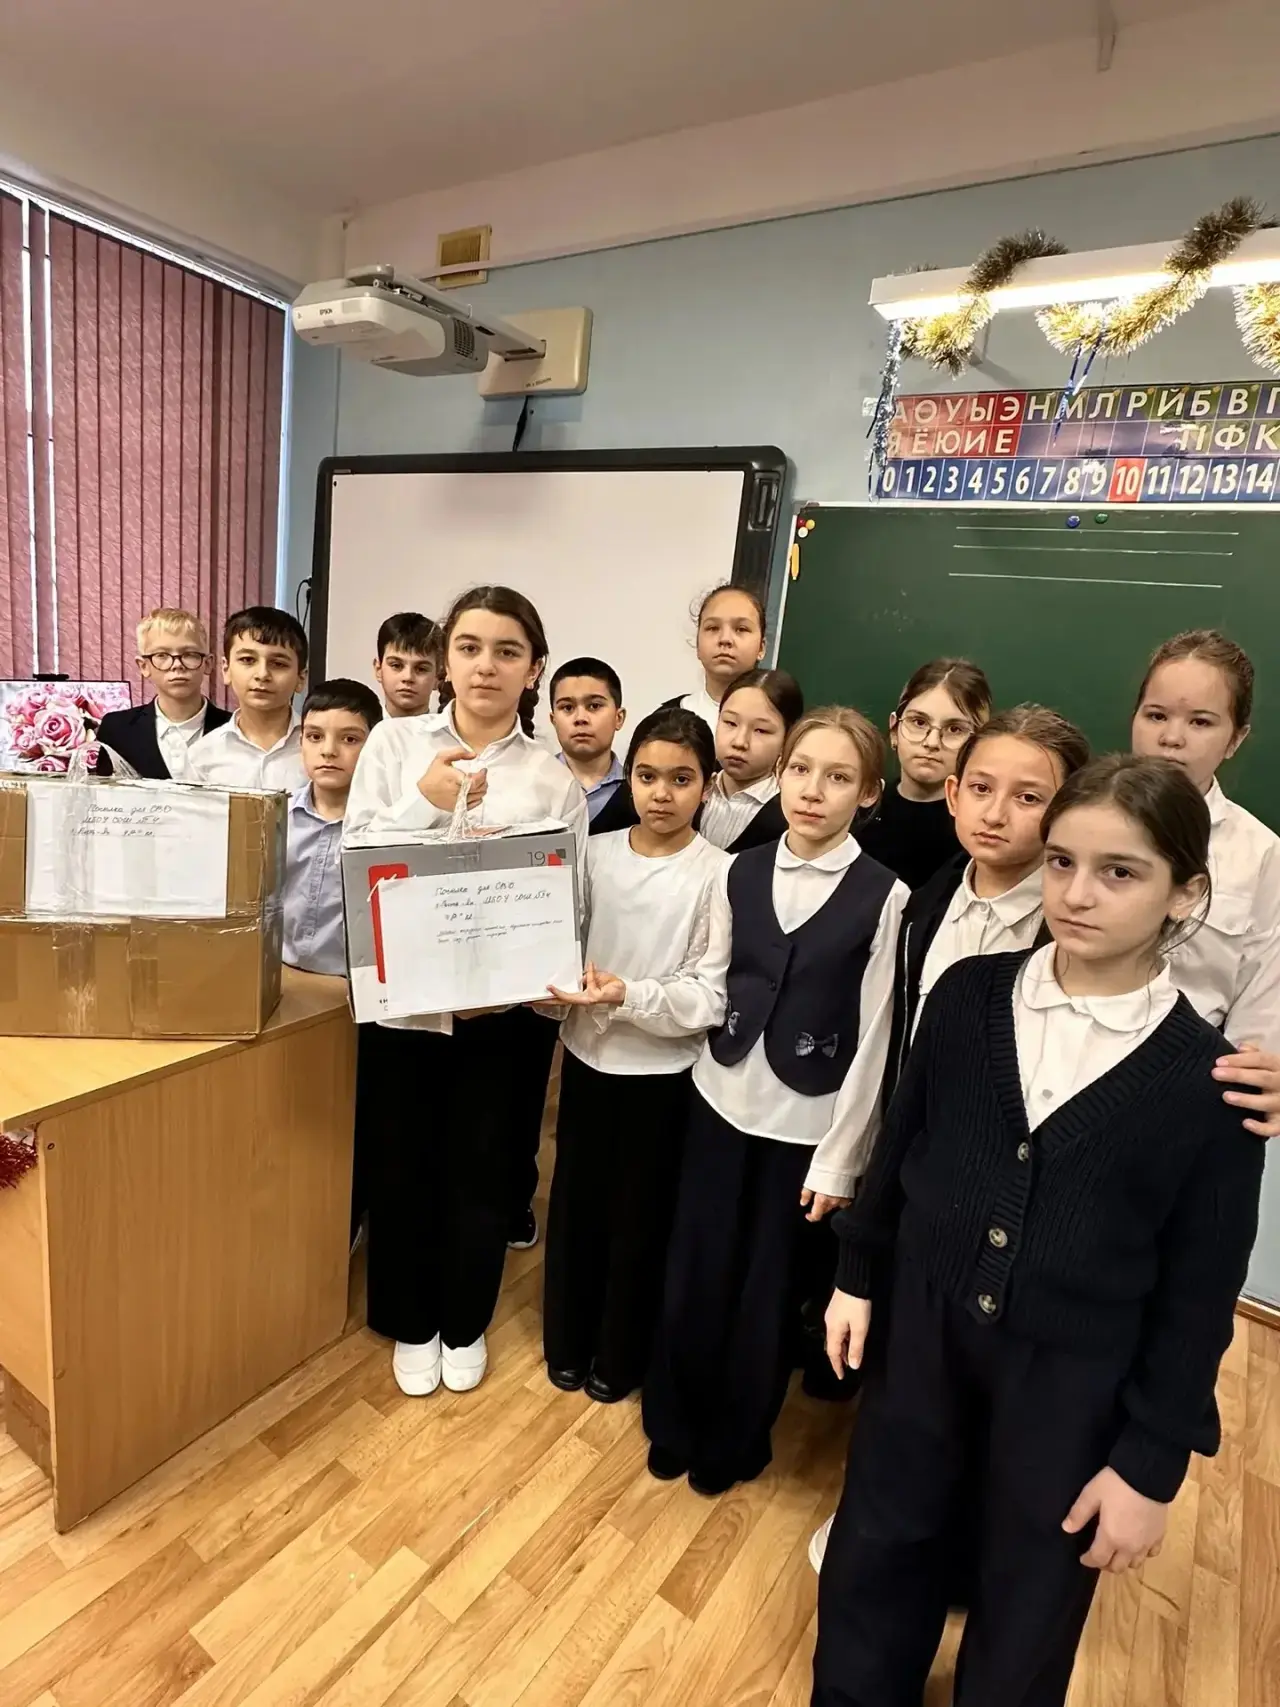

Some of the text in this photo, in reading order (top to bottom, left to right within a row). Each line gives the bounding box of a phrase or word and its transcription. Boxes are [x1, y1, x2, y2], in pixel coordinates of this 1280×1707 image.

[914, 399, 938, 422] О
[945, 398, 965, 423] У
[969, 397, 994, 422] Ы
[999, 395, 1020, 421] Э
[1026, 395, 1051, 421] Н
[1055, 393, 1083, 419] М
[1089, 392, 1114, 419] Л
[1126, 391, 1148, 417] Р
[1157, 387, 1185, 417] Й
[1190, 389, 1212, 416] Б
[1227, 388, 1249, 415] В
[887, 431, 900, 454] Я
[912, 427, 928, 454] Ё
[934, 430, 960, 454] Ю
[963, 429, 987, 454] И
[995, 429, 1014, 454] Е
[1214, 424, 1246, 451] Ф
[1254, 424, 1280, 451] К
[882, 462, 1274, 496] 0 1 2 3 4 5 6 7 8 9 10 11 12 13 14
